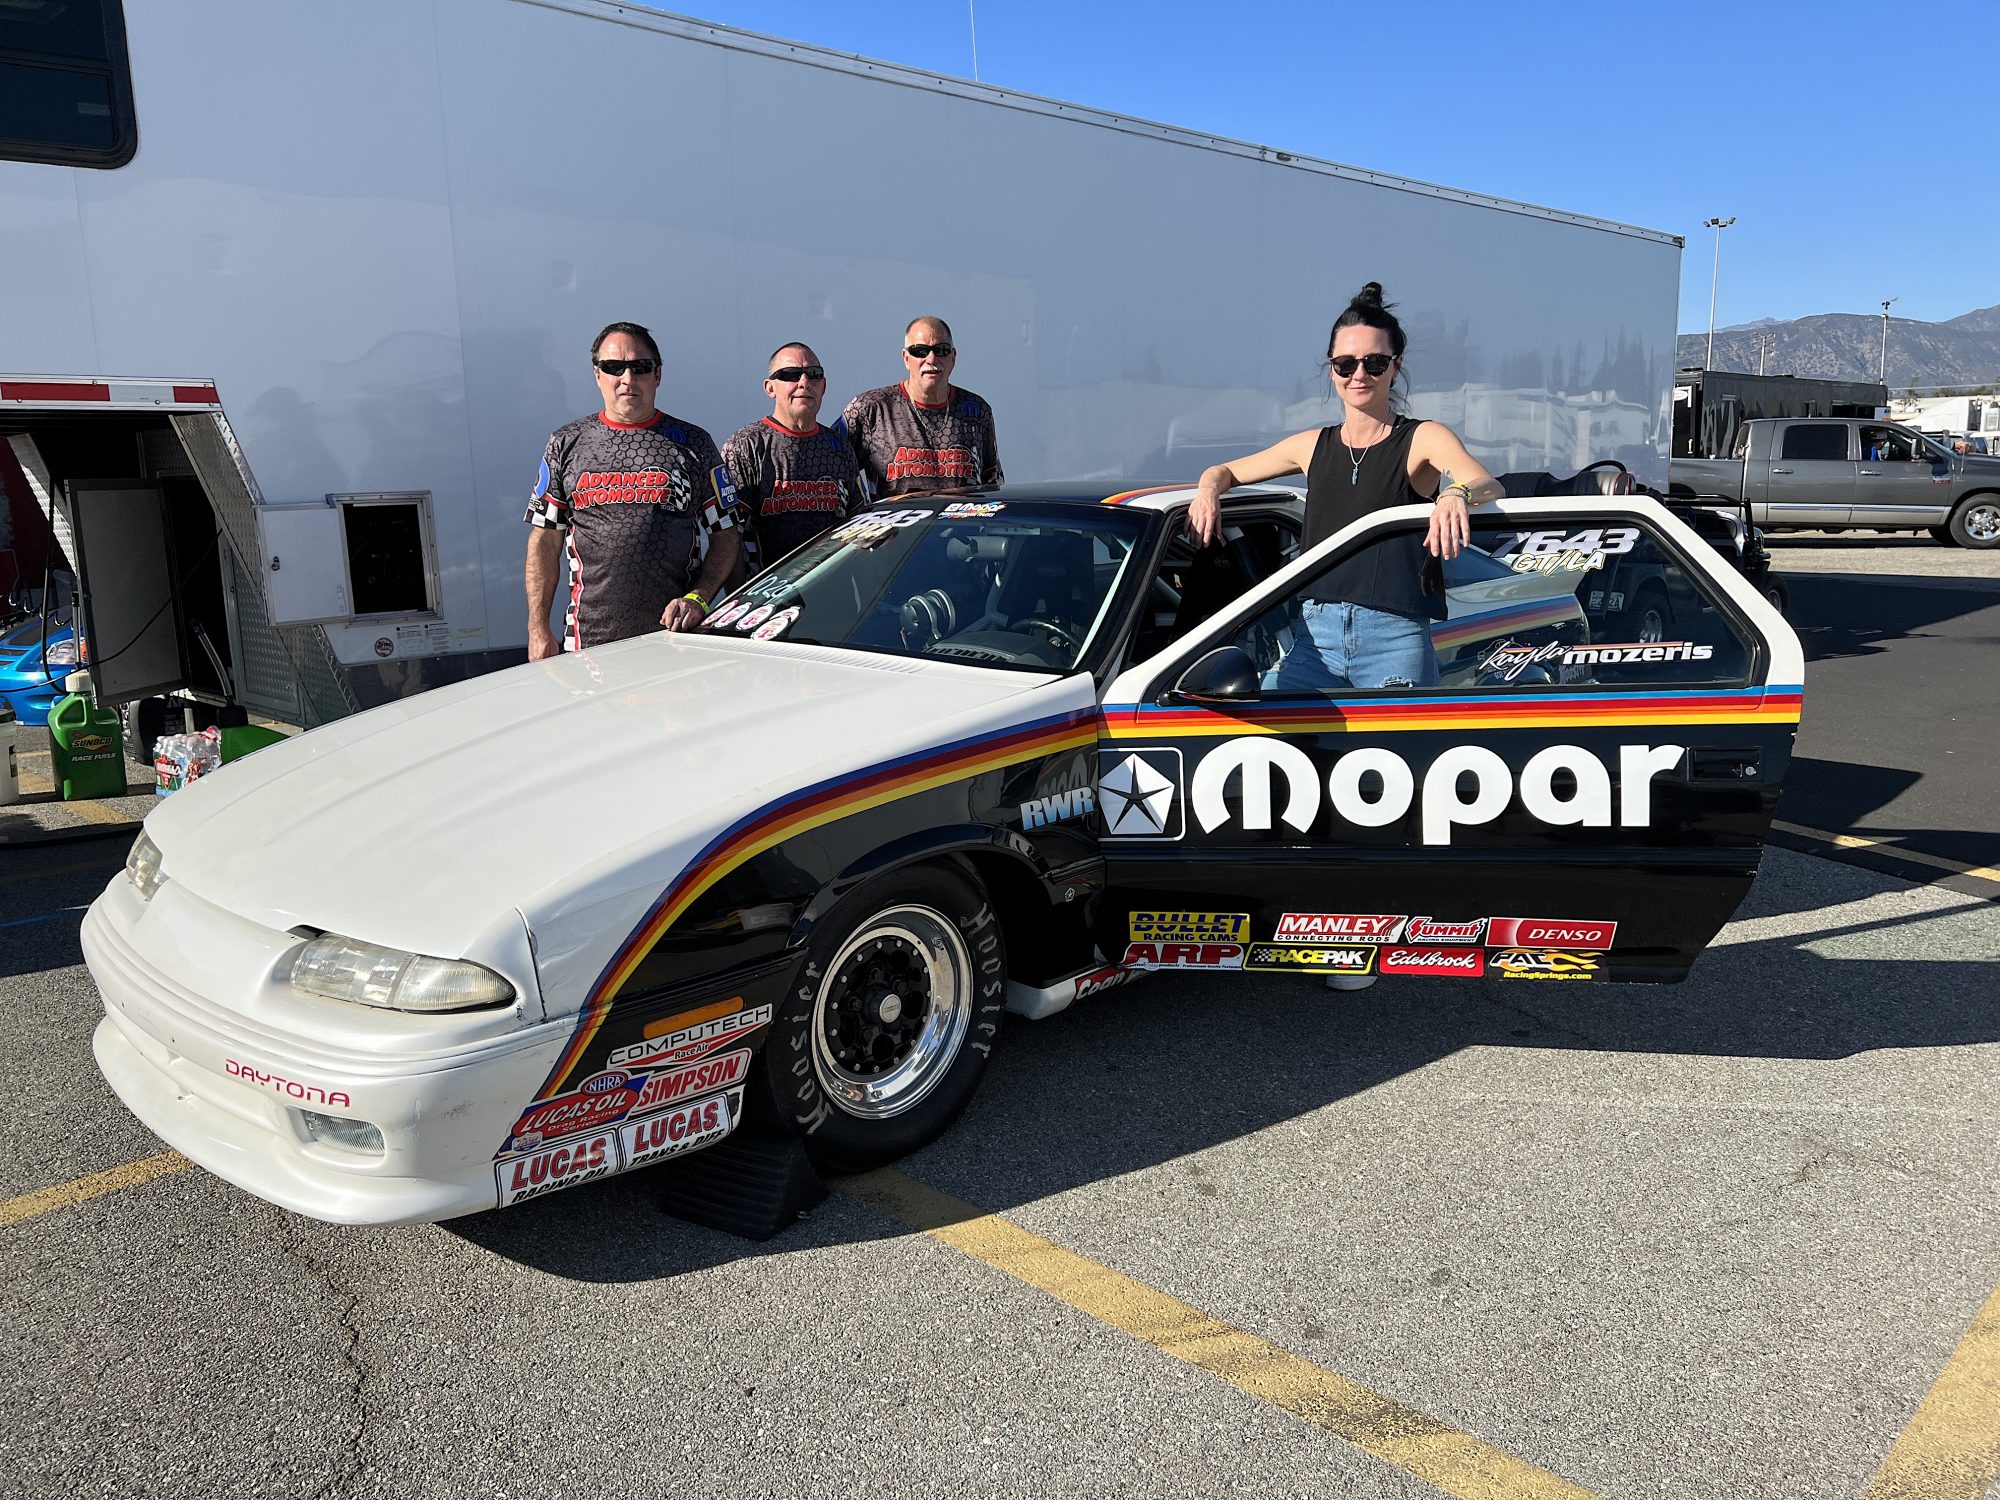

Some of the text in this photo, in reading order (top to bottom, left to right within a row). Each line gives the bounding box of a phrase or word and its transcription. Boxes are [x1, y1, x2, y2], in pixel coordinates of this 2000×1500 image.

[894, 446, 971, 464] ADVANCED
[576, 471, 669, 491] ADVANCED
[886, 462, 974, 481] AUTOMOTIVE
[771, 479, 839, 498] ADVANCED
[760, 496, 841, 516] AUTOMOTIVE
[1488, 527, 1641, 558] 7643
[1511, 550, 1606, 577] GT/LA
[1478, 640, 1574, 681] kayla
[1562, 641, 1714, 665] mozeris
[72, 736, 112, 748] SUNOCO
[72, 752, 117, 762] RACE FUELS
[1191, 735, 1686, 846] Mopar
[1020, 786, 1095, 831] RWR
[1133, 913, 1248, 933] BULLET
[1280, 916, 1390, 934] MANLEY
[1143, 933, 1239, 942] RACING CAMS
[1528, 928, 1602, 941] DENSO
[1123, 943, 1242, 965] ARP
[1270, 949, 1365, 965] RACEPAK
[1387, 950, 1476, 968] Edelbrock
[1077, 971, 1126, 1000] Coan
[609, 1005, 770, 1065] COMPUTECH
[225, 1058, 351, 1108] DAYTONA
[588, 1076, 621, 1093] NHRA
[637, 1056, 741, 1108] SIMPSON
[521, 1091, 628, 1133] LUCAS OIL
[547, 1109, 620, 1131] Drag Racing
[562, 1119, 599, 1133] Series
[634, 1101, 720, 1154] LUCAS
[628, 1144, 679, 1167] TRANS
[692, 1128, 725, 1145] DIFF
[511, 1138, 607, 1191] LUCAS
[512, 1174, 581, 1203] RACING
